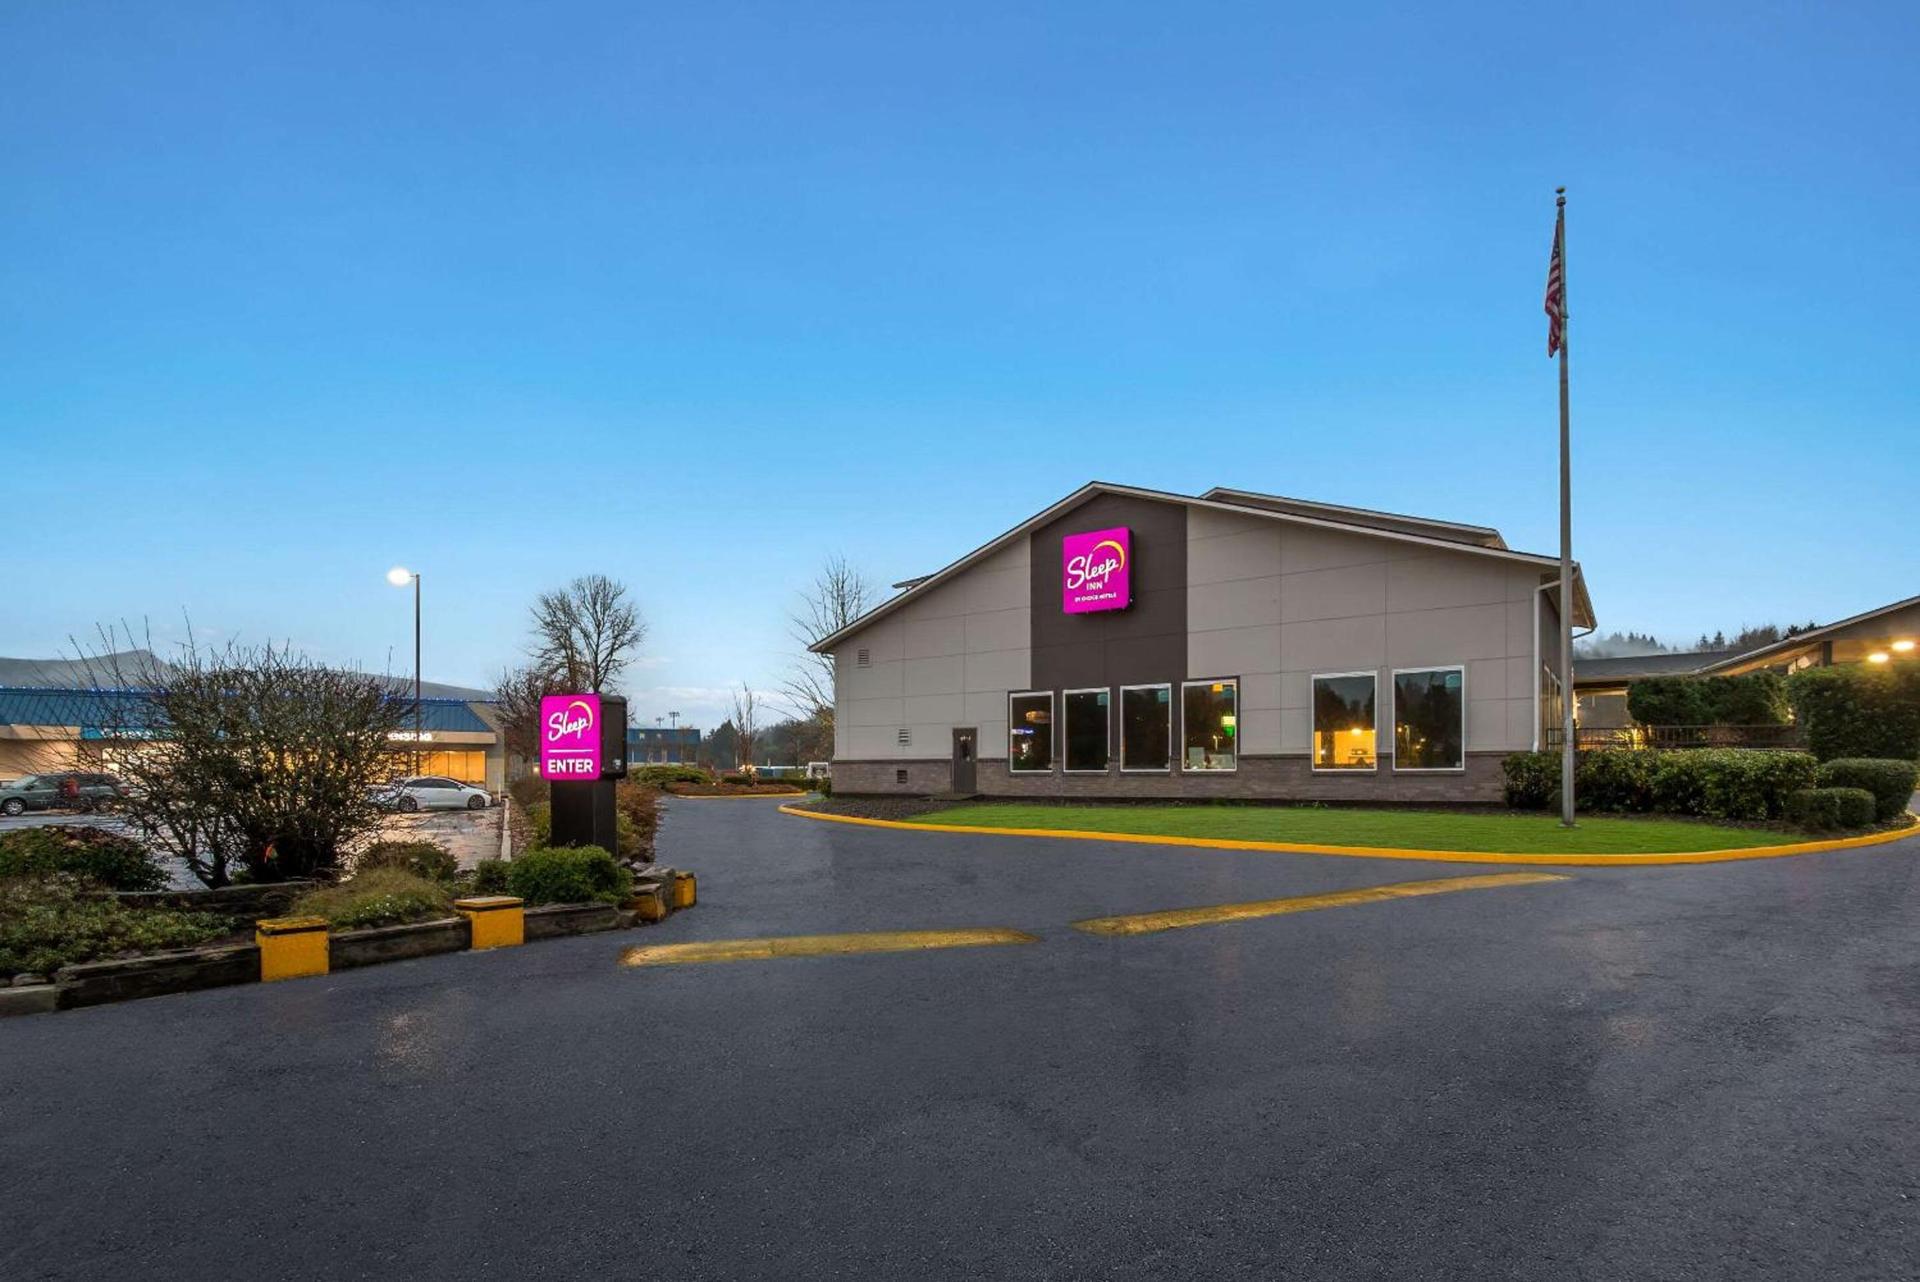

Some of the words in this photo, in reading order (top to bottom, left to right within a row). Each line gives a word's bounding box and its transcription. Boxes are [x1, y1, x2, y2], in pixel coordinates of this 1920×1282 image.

[1067, 553, 1119, 589] Sleep
[1086, 581, 1103, 590] INN
[548, 711, 588, 741] Sleep
[548, 759, 593, 773] ENTER
